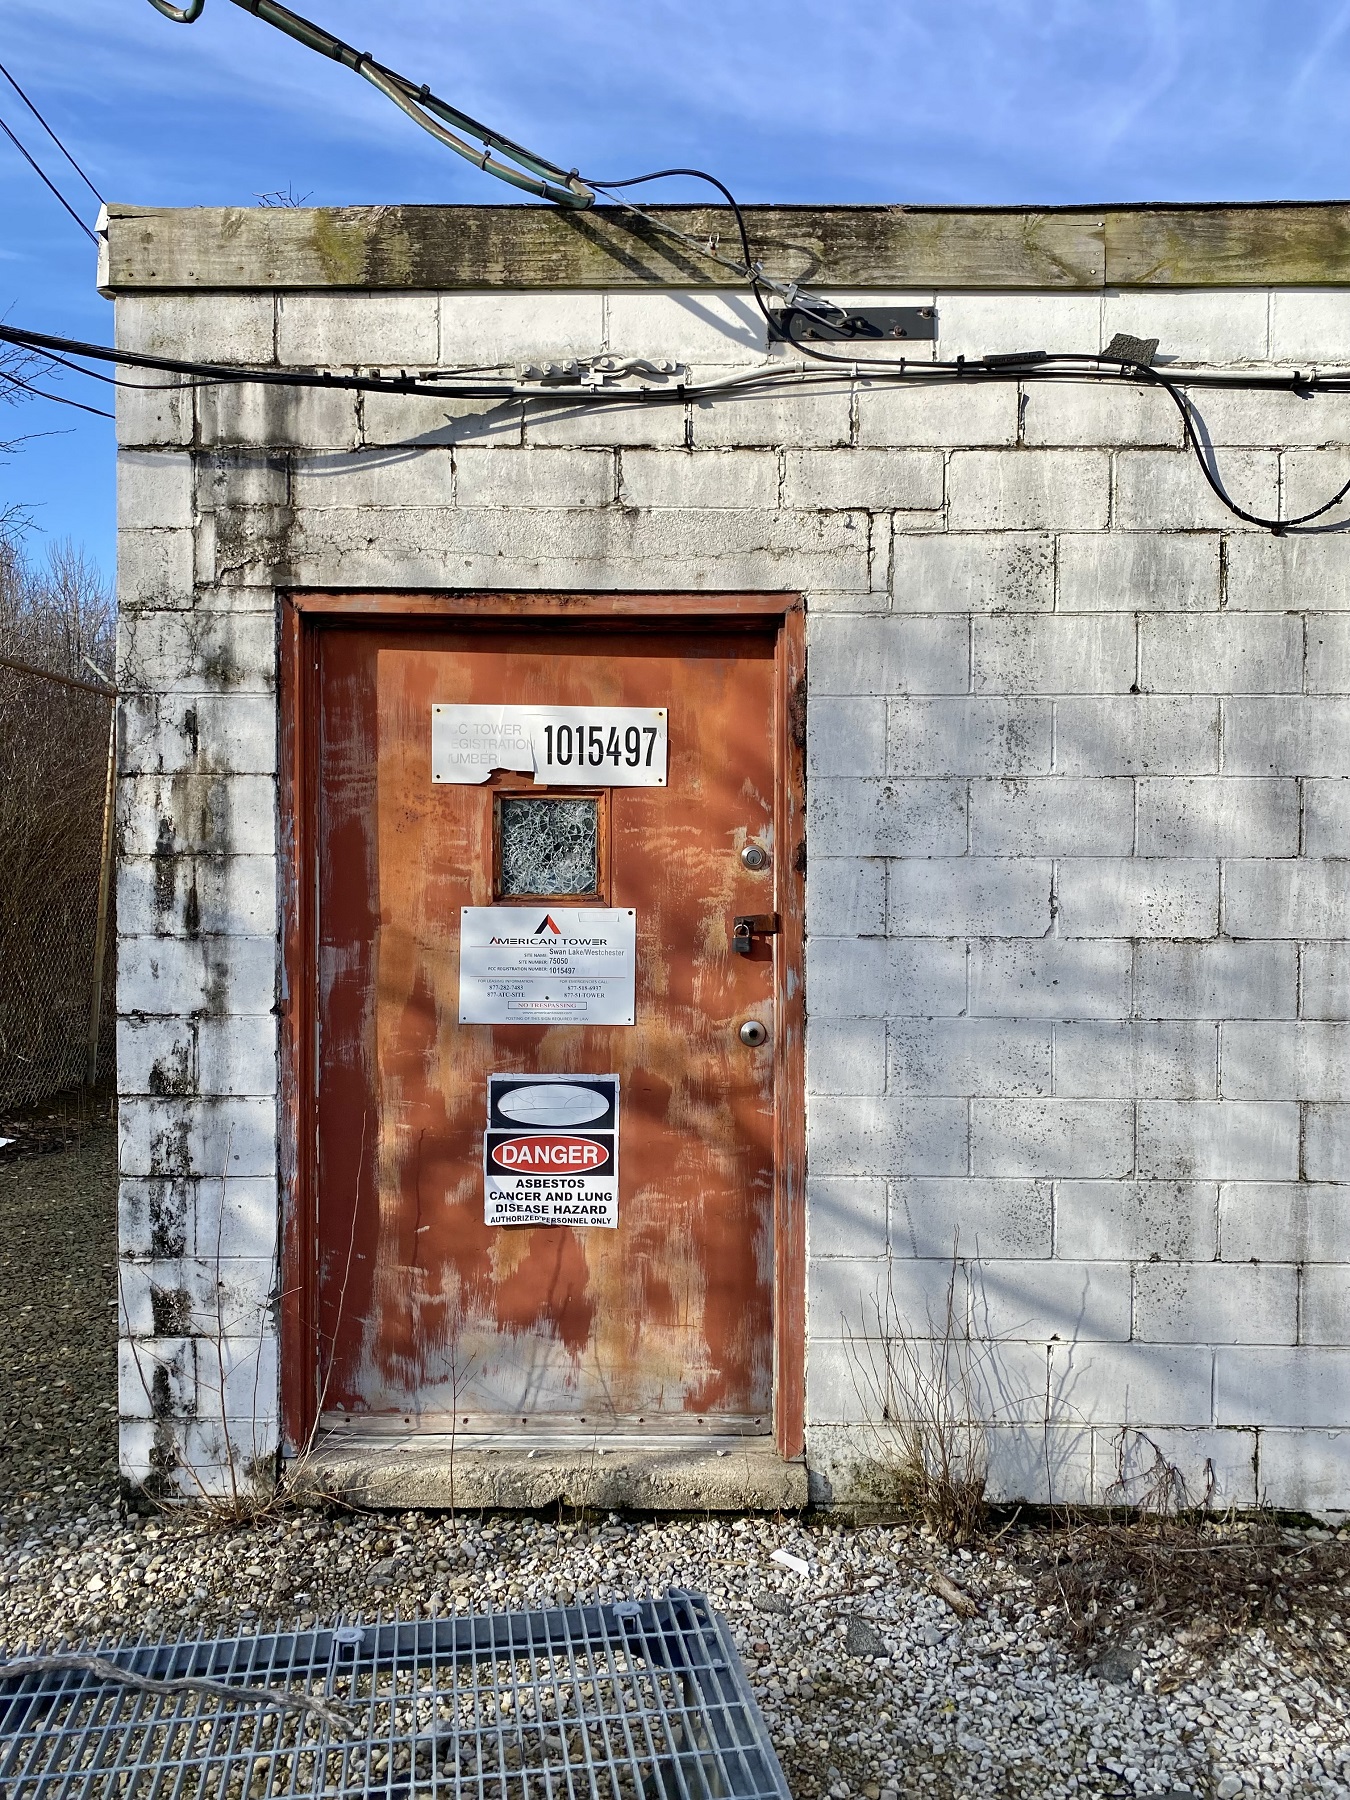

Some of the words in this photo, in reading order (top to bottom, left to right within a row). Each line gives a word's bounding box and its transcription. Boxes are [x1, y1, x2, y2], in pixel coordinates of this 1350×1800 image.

[473, 723, 522, 735] TOWER
[450, 738, 536, 750] EGISTRATION
[543, 725, 658, 767] 1015497
[489, 936, 557, 945] AMERICAN
[561, 938, 608, 946] TOWER
[568, 948, 625, 956] Lake/Westchester
[549, 957, 569, 965] 75050
[549, 967, 576, 975] 1015497
[502, 1145, 598, 1164] DANGER
[515, 1178, 585, 1189] ASBESTOS
[489, 1191, 542, 1201] CANCER
[545, 1192, 573, 1201] AND
[577, 1192, 613, 1202] LUNG
[495, 1203, 550, 1214] DISEASE
[553, 1205, 607, 1215] HAZARD
[490, 1214, 539, 1224] AUTHORIZED
[541, 1216, 589, 1225] PERSONNEL
[591, 1217, 612, 1225] ONLY
